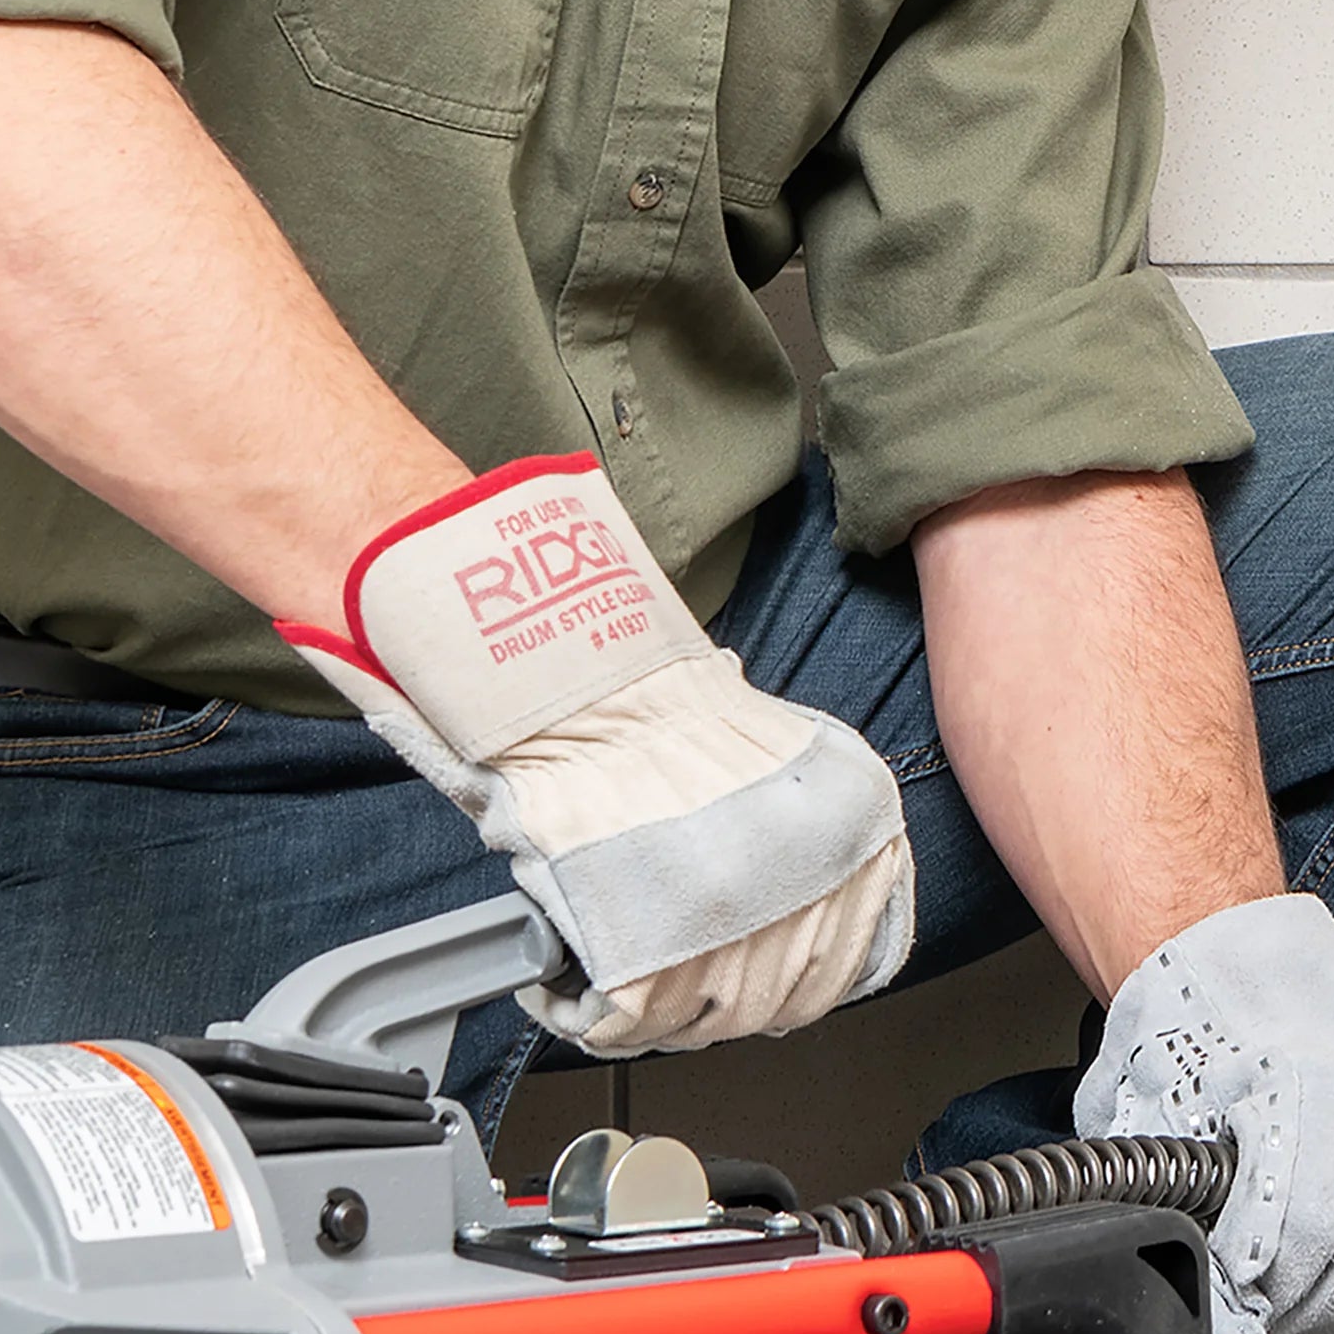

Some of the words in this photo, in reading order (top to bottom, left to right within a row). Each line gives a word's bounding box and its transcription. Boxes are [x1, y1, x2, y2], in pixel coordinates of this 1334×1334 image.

[494, 510, 536, 541] FOR
[533, 498, 566, 524] USE
[453, 521, 628, 623] RIDGID
[489, 619, 557, 665] DRUM
[558, 591, 618, 633] STYLE
[608, 611, 651, 641] 41937
